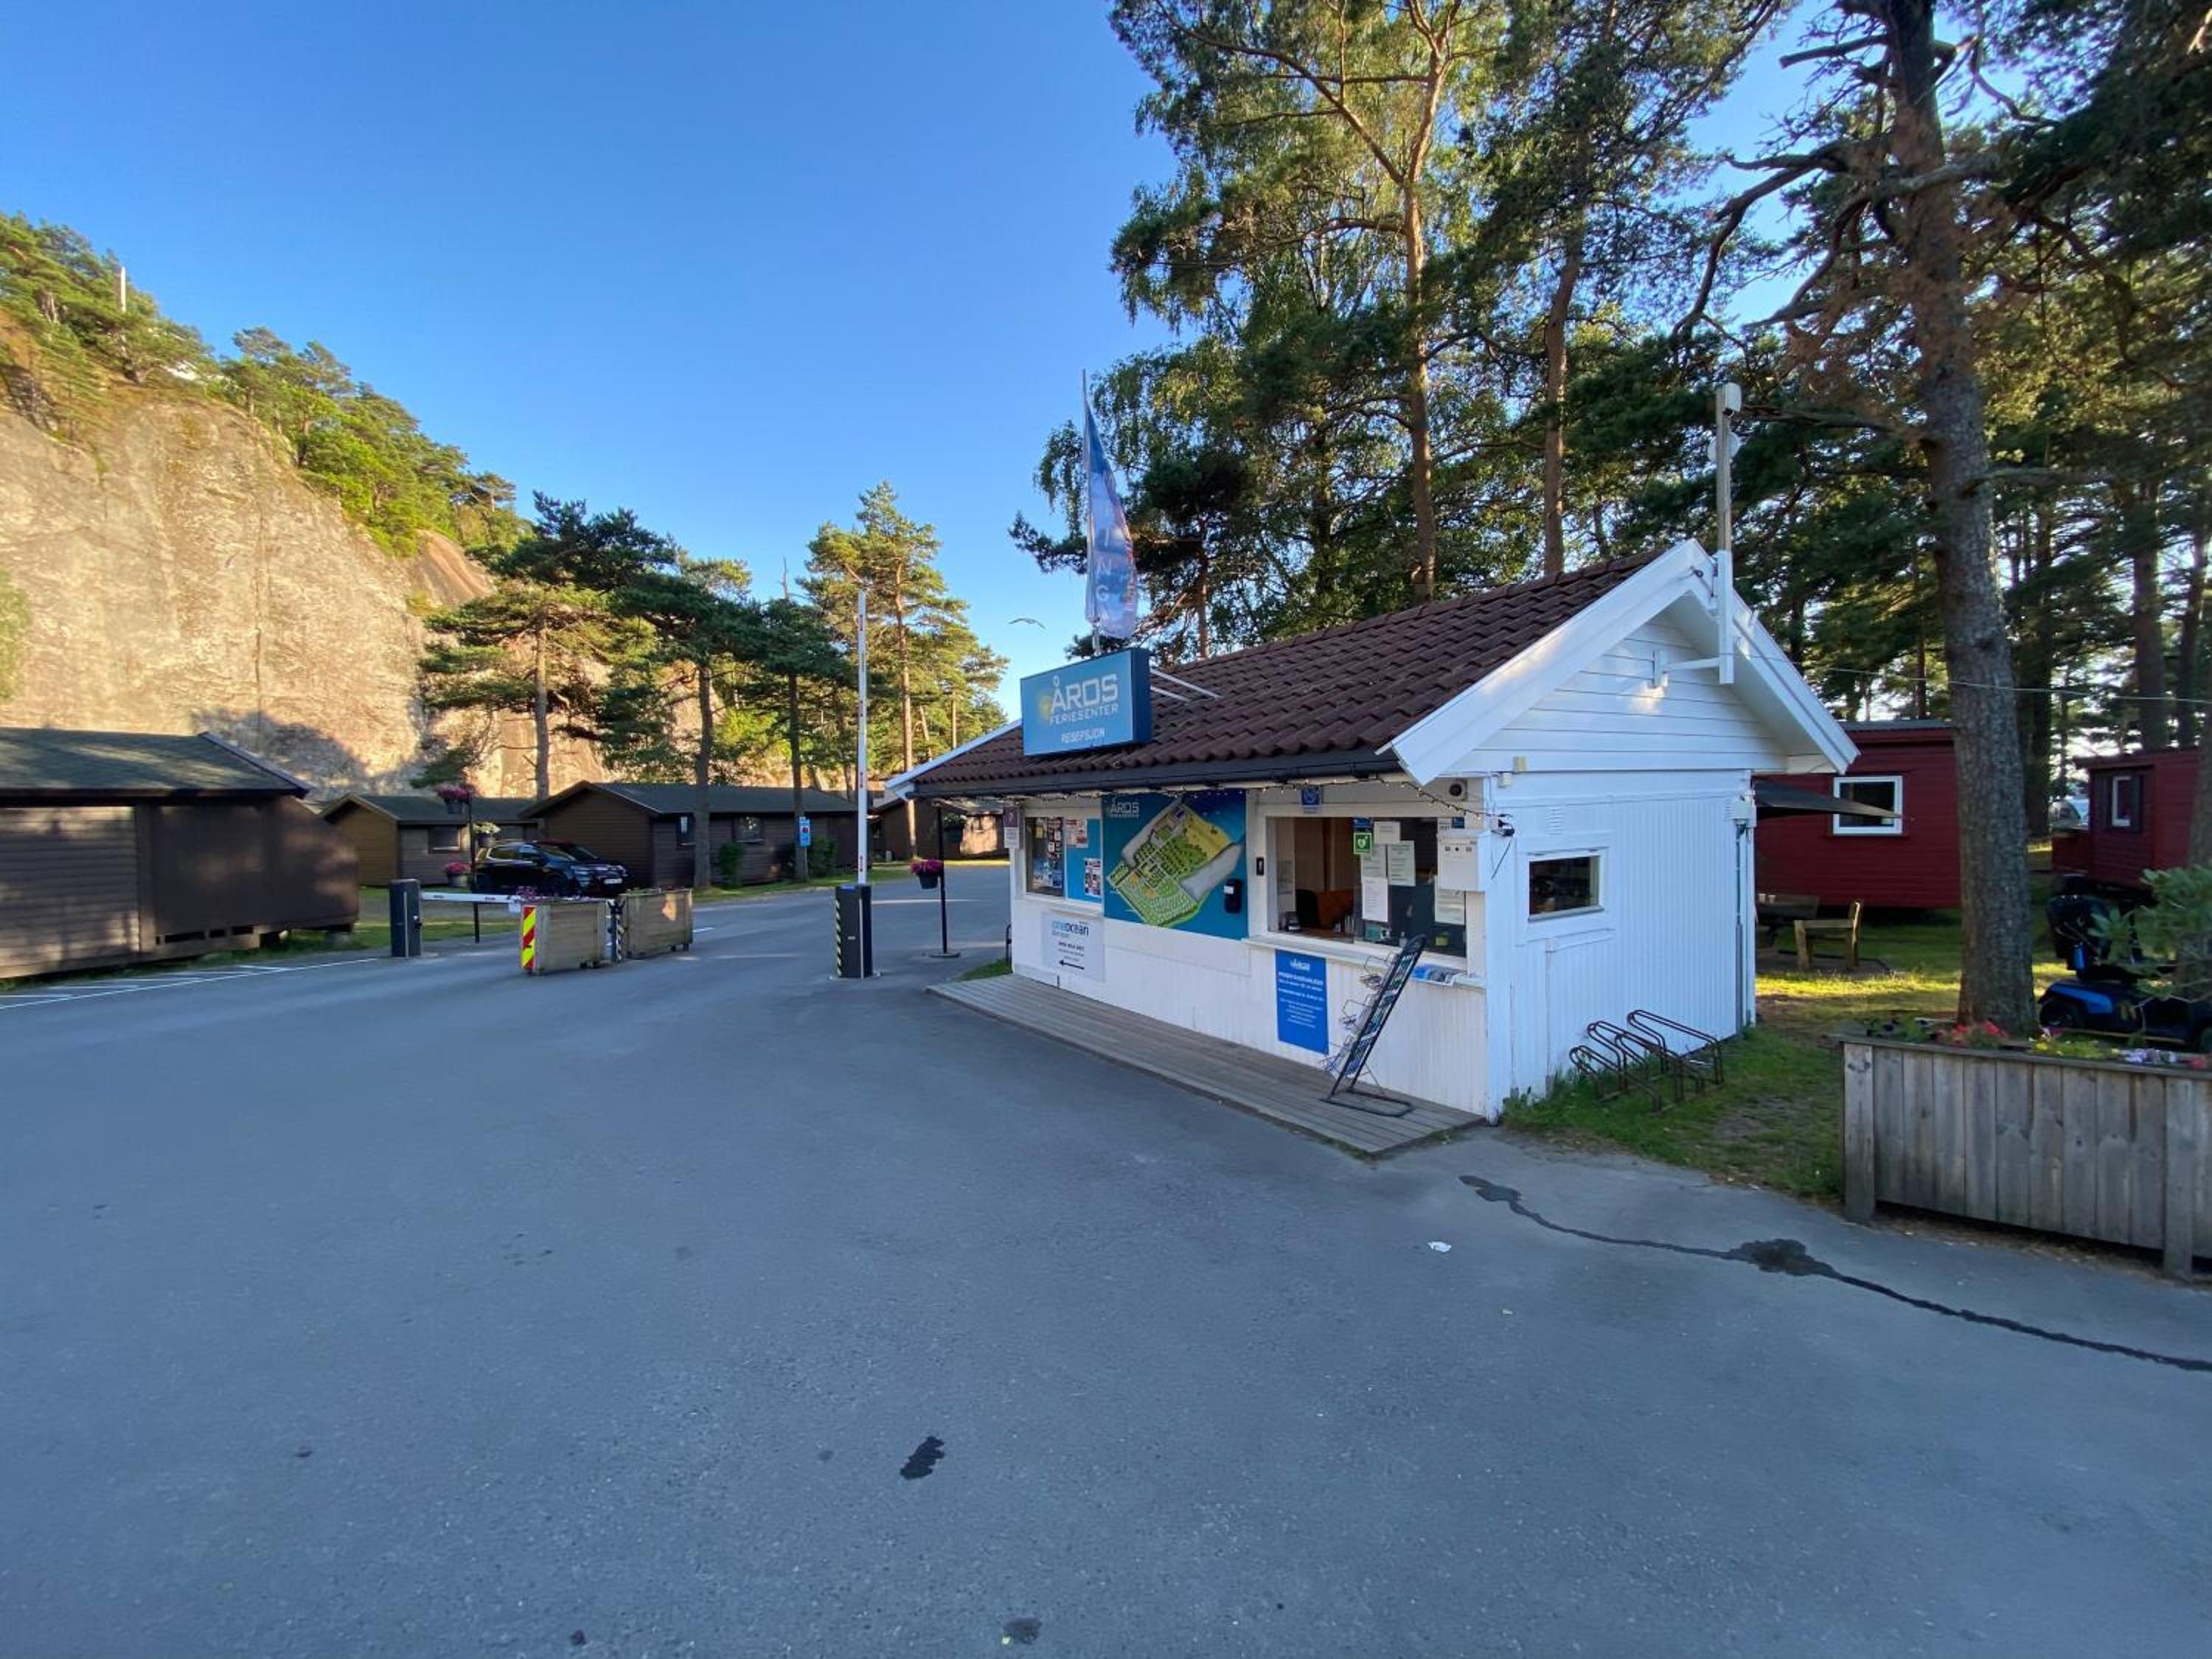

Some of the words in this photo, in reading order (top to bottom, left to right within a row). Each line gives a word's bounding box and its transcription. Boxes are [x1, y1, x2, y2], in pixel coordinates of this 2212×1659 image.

[1050, 674, 1119, 714] ÅROS
[1049, 703, 1119, 725] FERIESENTER
[1061, 728, 1105, 744] RESEPSJON
